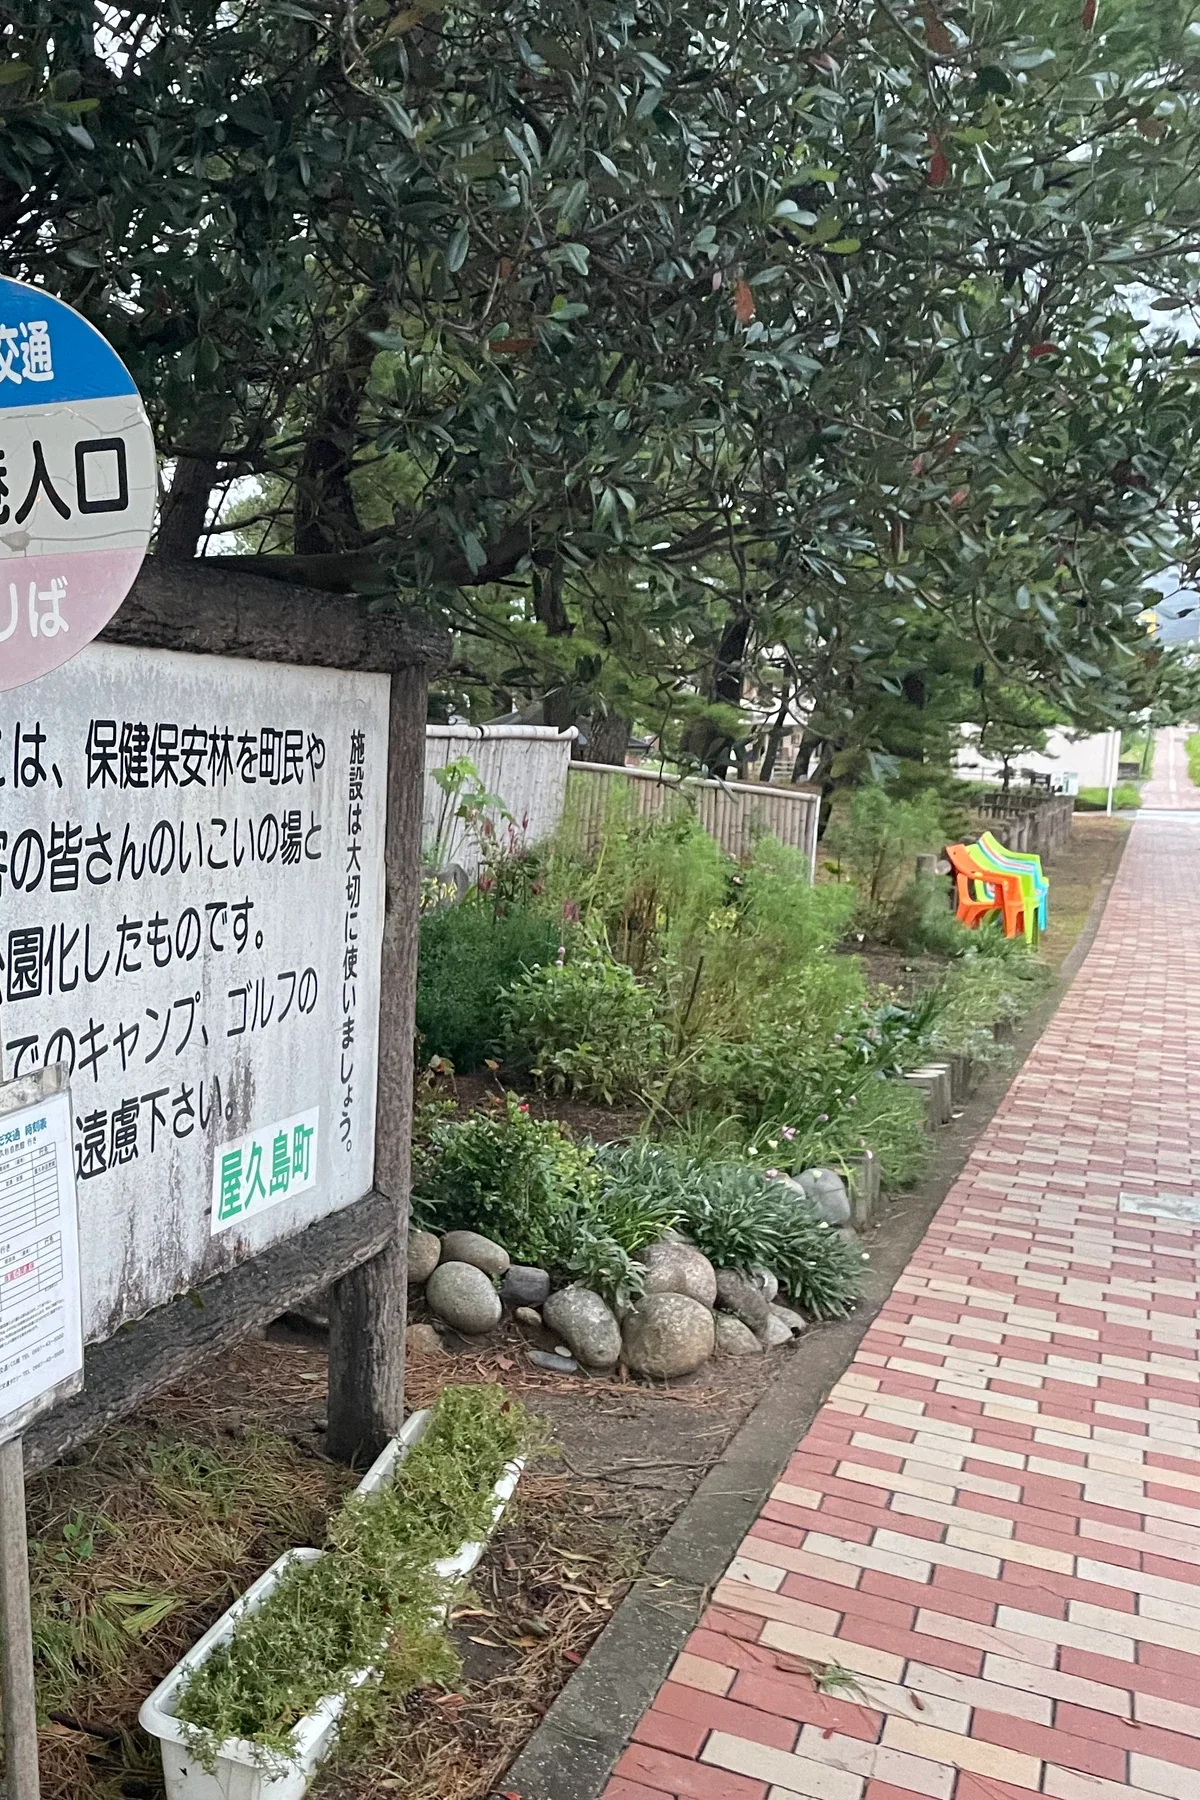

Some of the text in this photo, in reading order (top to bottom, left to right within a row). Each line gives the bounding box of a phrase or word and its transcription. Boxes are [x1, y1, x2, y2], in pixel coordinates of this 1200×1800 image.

[339, 728, 366, 1153] 施設は大切に使いましょう。
[217, 1123, 314, 1221] 屋久島町
